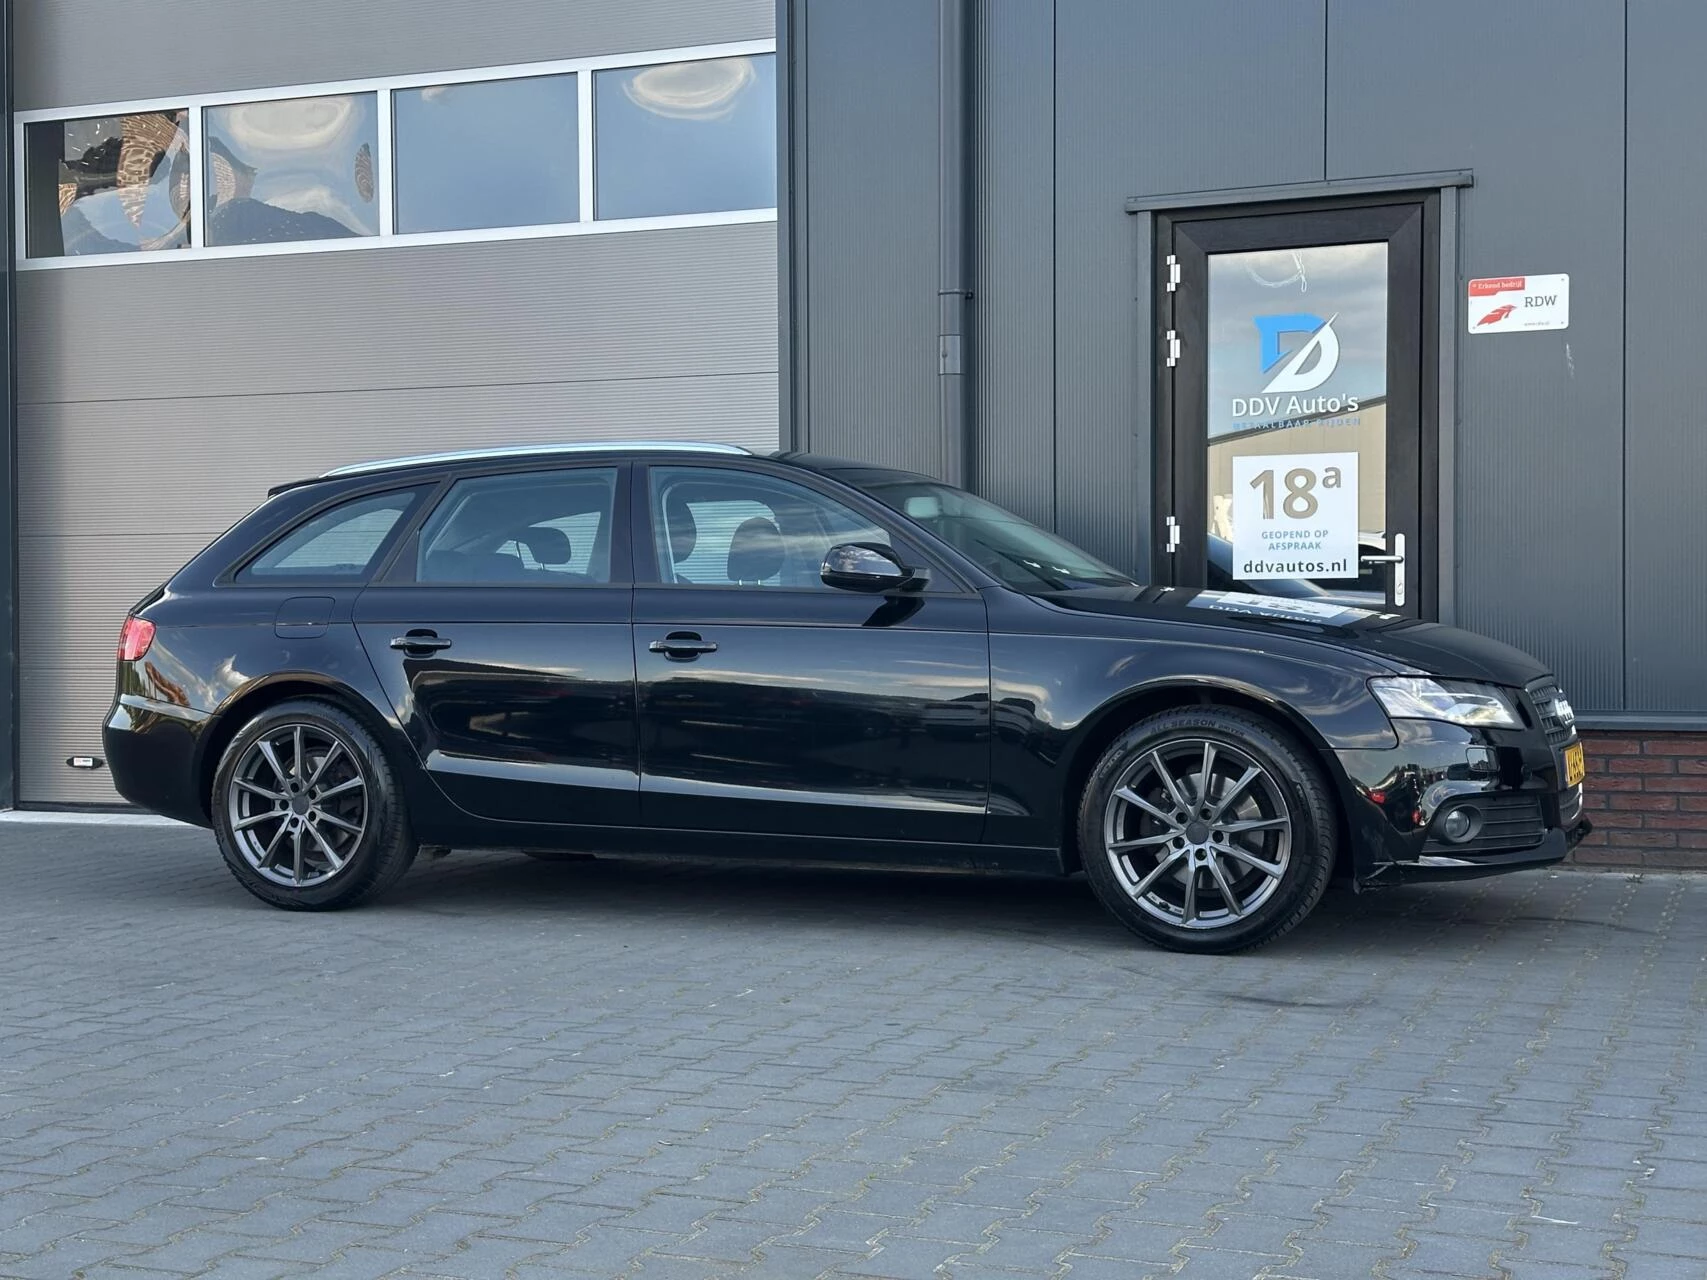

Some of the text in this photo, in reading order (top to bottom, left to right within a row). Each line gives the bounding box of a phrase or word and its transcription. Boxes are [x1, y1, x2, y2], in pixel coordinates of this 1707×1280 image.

[1524, 294, 1558, 308] RDW
[1232, 393, 1360, 417] DDV Auto's
[1261, 529, 1329, 539] GEOPEND OP
[1268, 541, 1322, 551] AFSPRAAK
[1243, 558, 1347, 574] ddvautos.nl
[1171, 718, 1216, 727] SEASON
